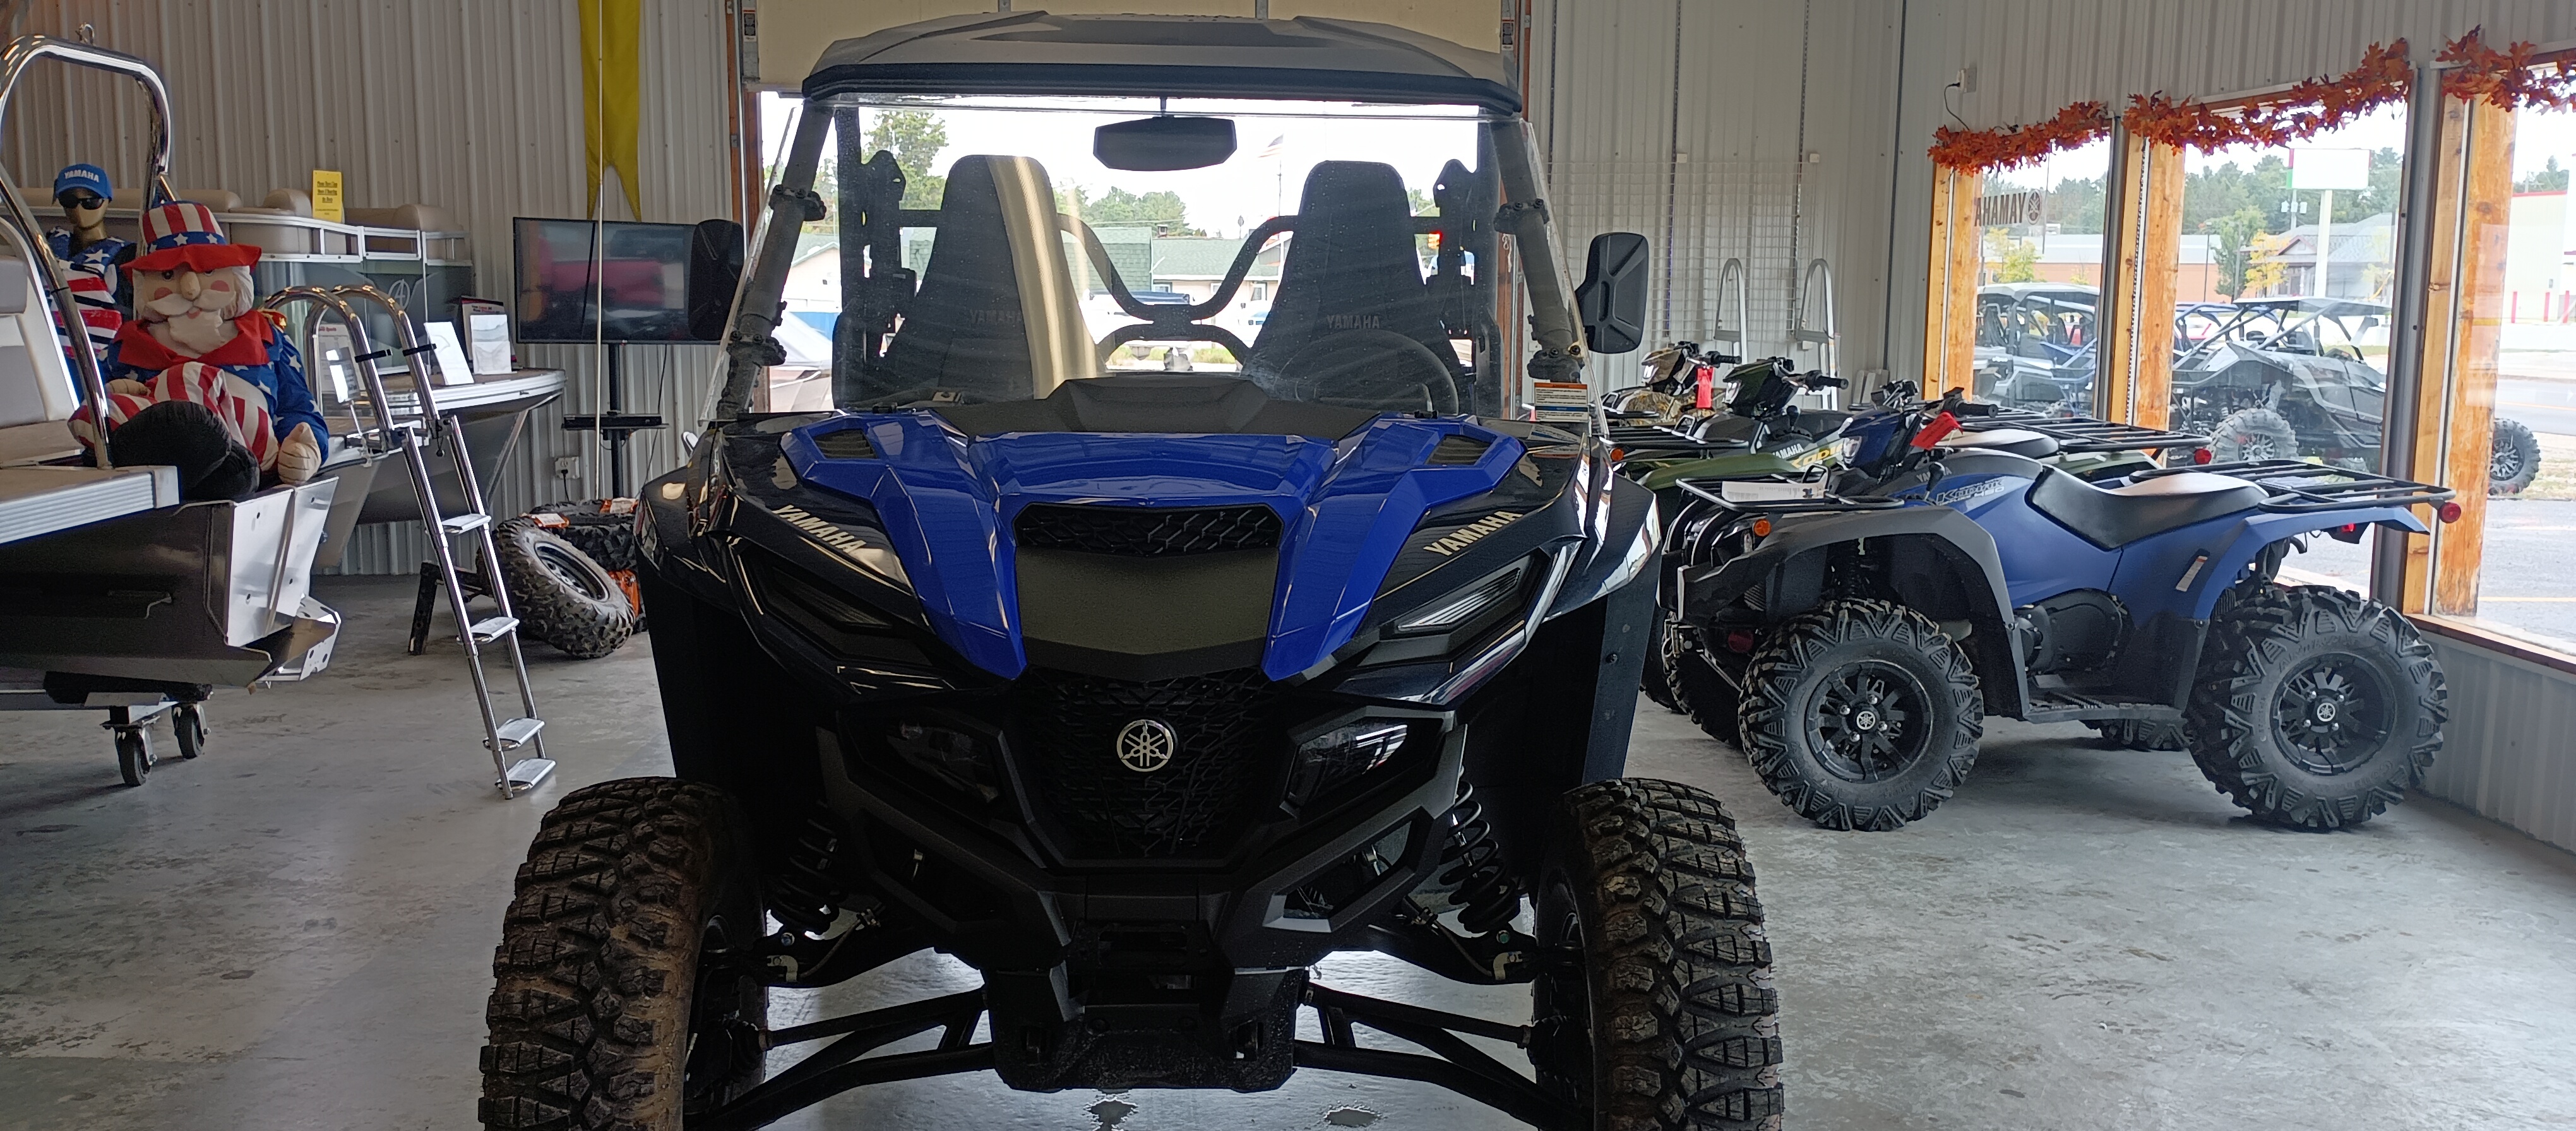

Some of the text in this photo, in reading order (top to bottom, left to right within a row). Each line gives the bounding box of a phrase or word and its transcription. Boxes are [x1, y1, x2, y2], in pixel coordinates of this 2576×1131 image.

[64, 169, 99, 182] YAMAHA
[1327, 314, 1380, 329] YAMAHA
[772, 504, 867, 554] YAMAHA
[1422, 511, 1524, 556] YAMAHA
